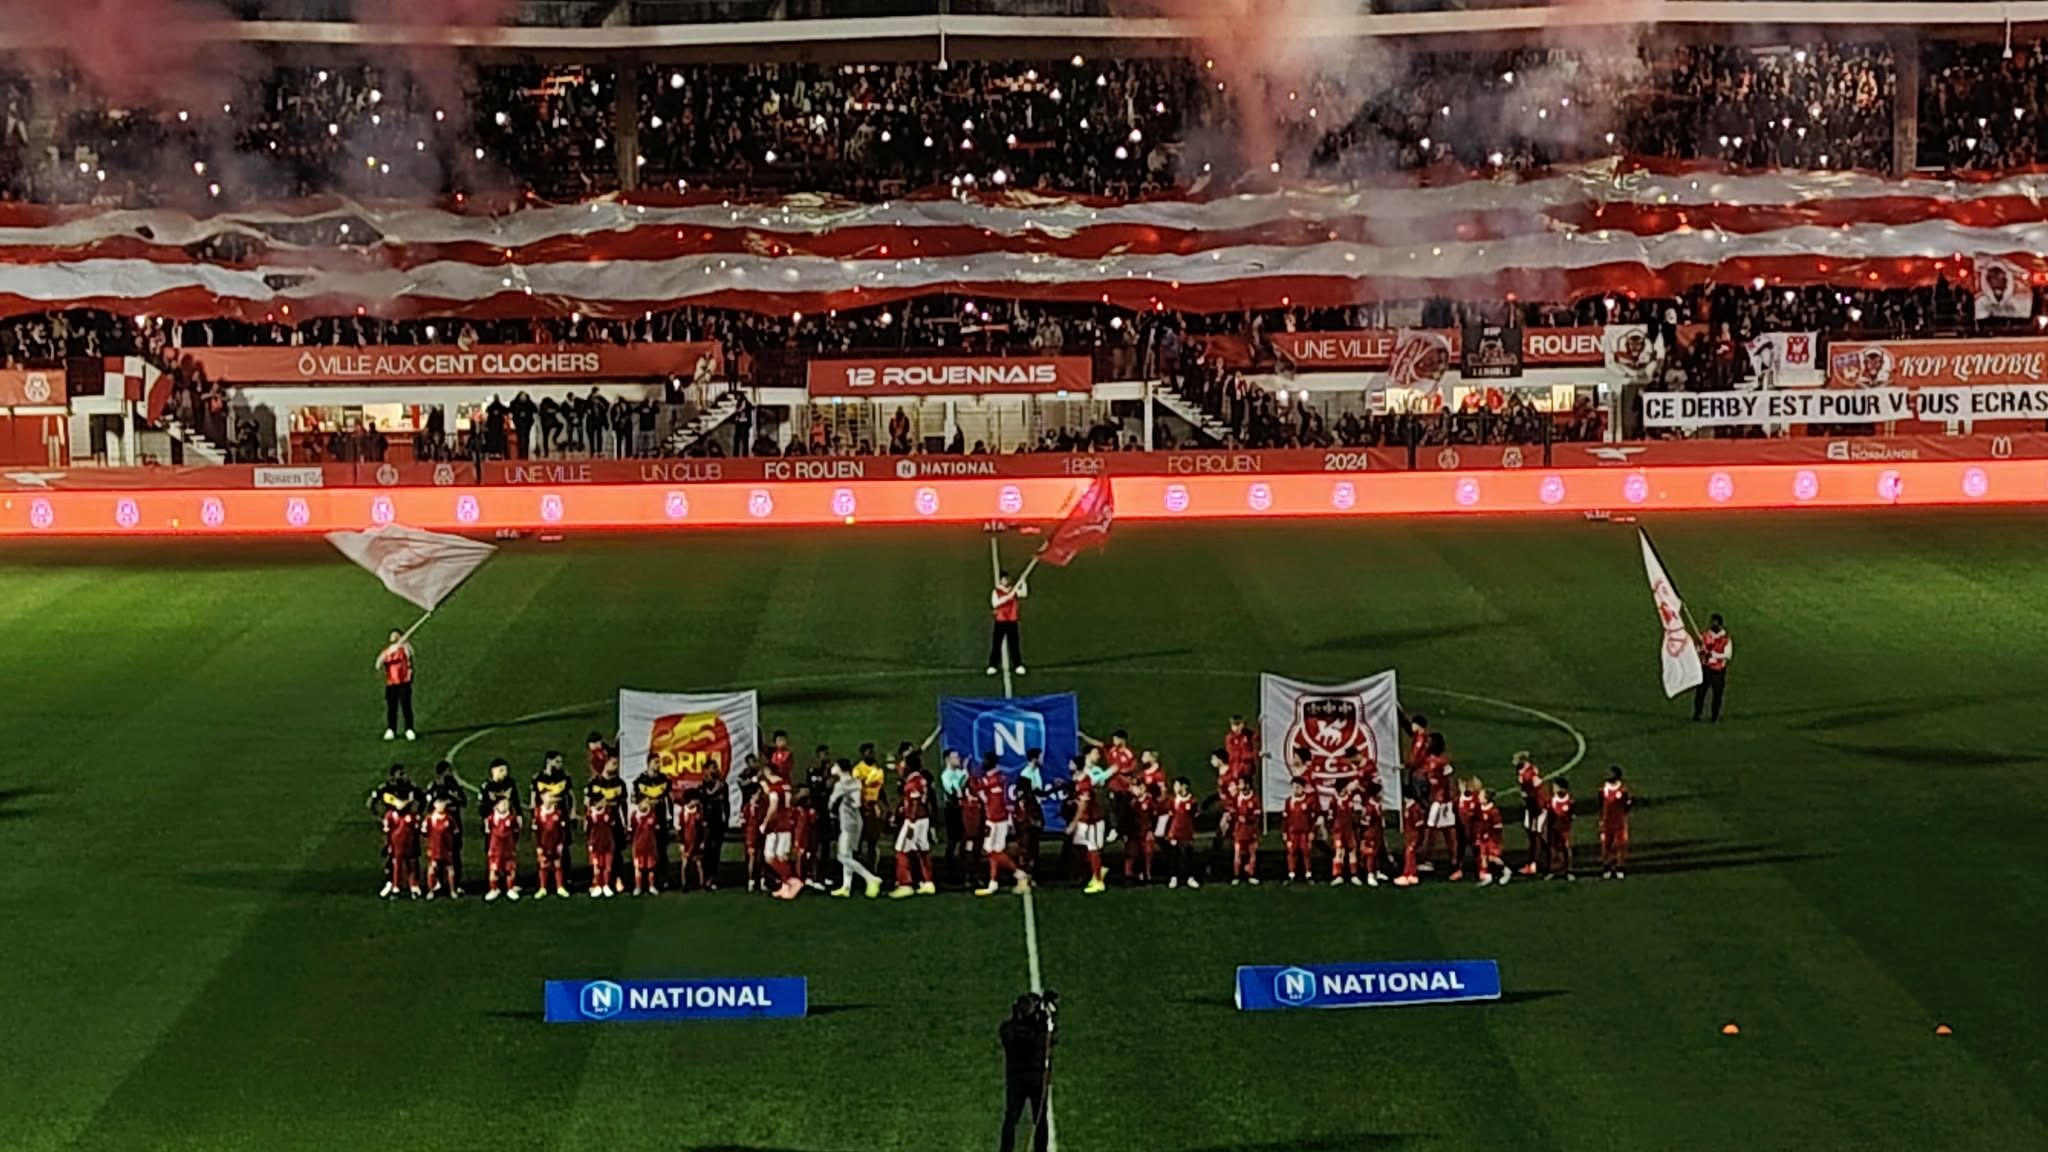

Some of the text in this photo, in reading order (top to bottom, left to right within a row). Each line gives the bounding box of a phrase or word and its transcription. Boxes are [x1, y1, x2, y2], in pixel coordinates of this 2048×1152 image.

[1294, 340, 1391, 360] UNE VILLE
[1529, 334, 1603, 354] ROUEN
[319, 354, 371, 375] VILLE
[375, 354, 416, 375] AUX
[419, 354, 477, 374] CENT
[481, 352, 599, 373] CLOCHERS
[1900, 352, 2046, 382] KOP LENOBLE
[846, 364, 1057, 387] 12 ROUENNAIS
[1645, 397, 1675, 419] CE
[1681, 395, 1759, 418] DERBY
[1769, 394, 1813, 417] EST
[1819, 393, 1880, 416] POUR
[504, 461, 864, 483] UNE VILLE UN CLUB FC ROUEN
[920, 461, 997, 475] NATIONAL
[1168, 456, 1193, 473] FC
[1324, 453, 1368, 471] 2024
[993, 721, 1026, 756] N
[1286, 971, 1465, 995] N NATIONAL
[592, 985, 772, 1009] N NATIONAL
